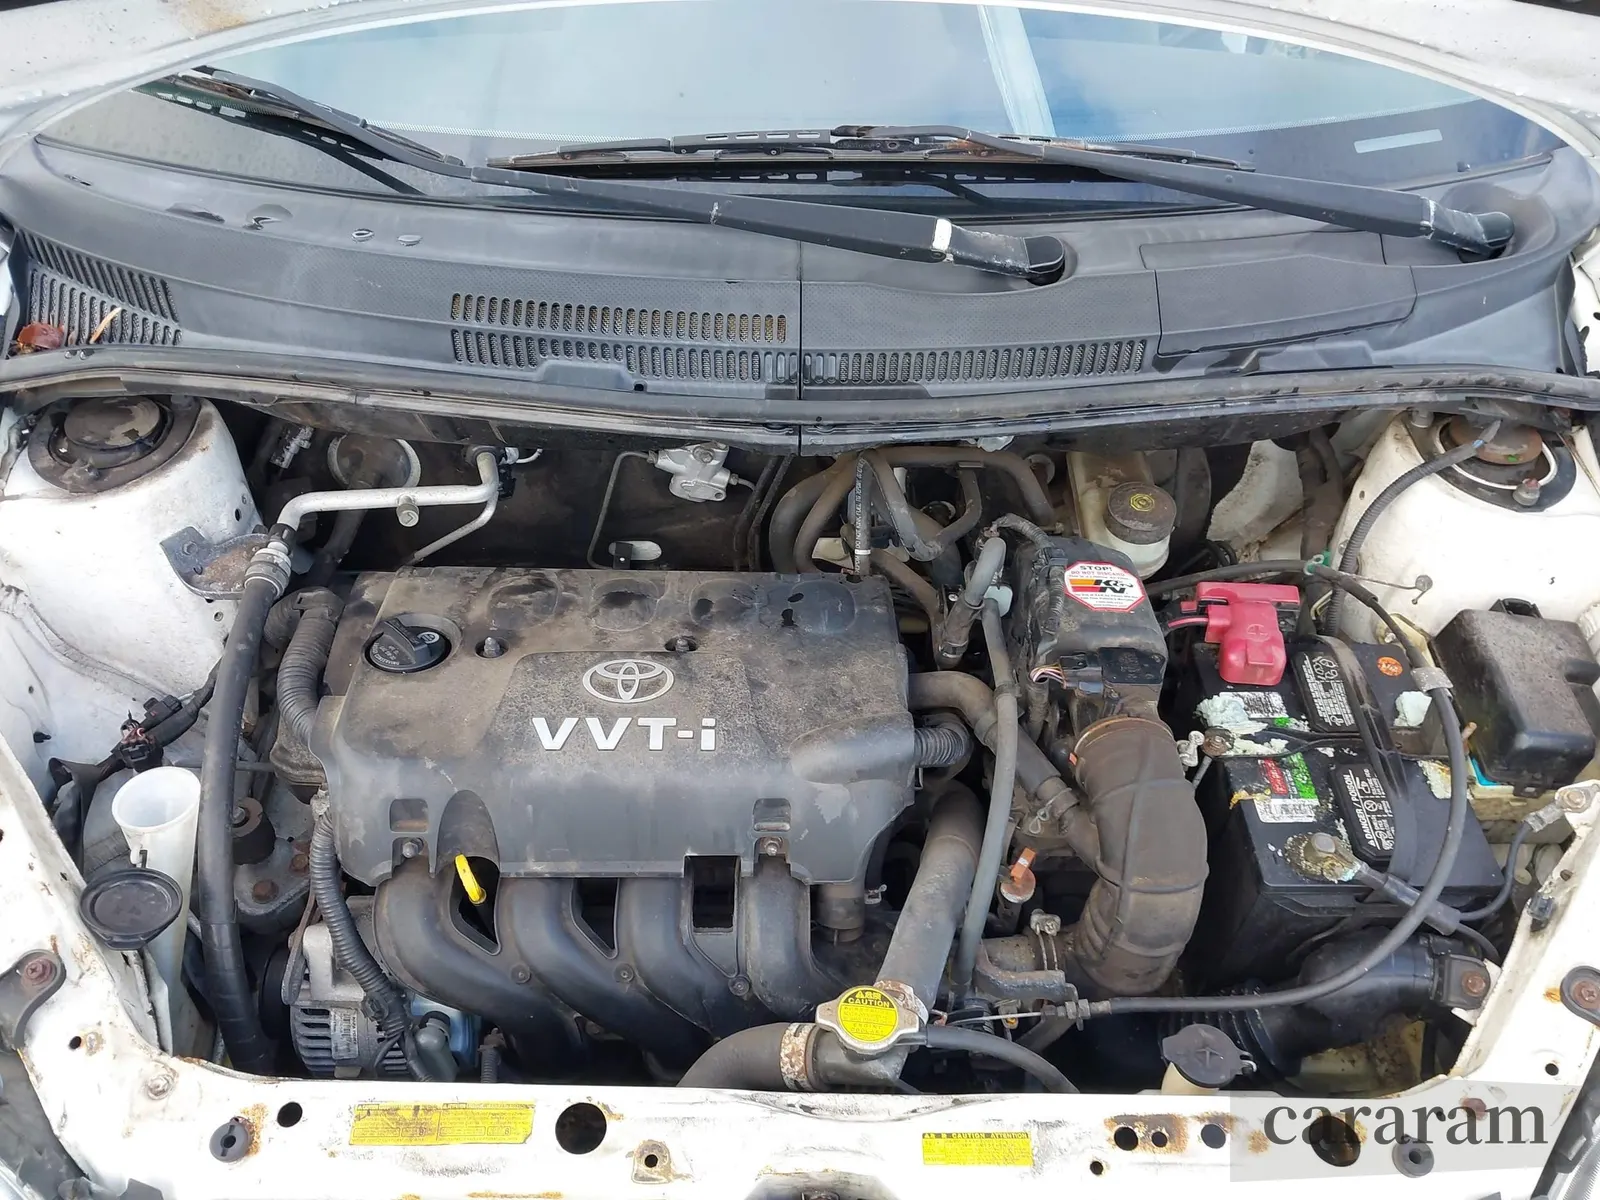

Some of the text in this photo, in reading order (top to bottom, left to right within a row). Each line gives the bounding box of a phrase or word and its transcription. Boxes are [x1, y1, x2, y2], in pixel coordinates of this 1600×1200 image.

[531, 717, 716, 751] VVT-i
[1343, 774, 1360, 802] POISON
[1355, 808, 1373, 839] DANGER
[848, 998, 889, 1008] CAUTION
